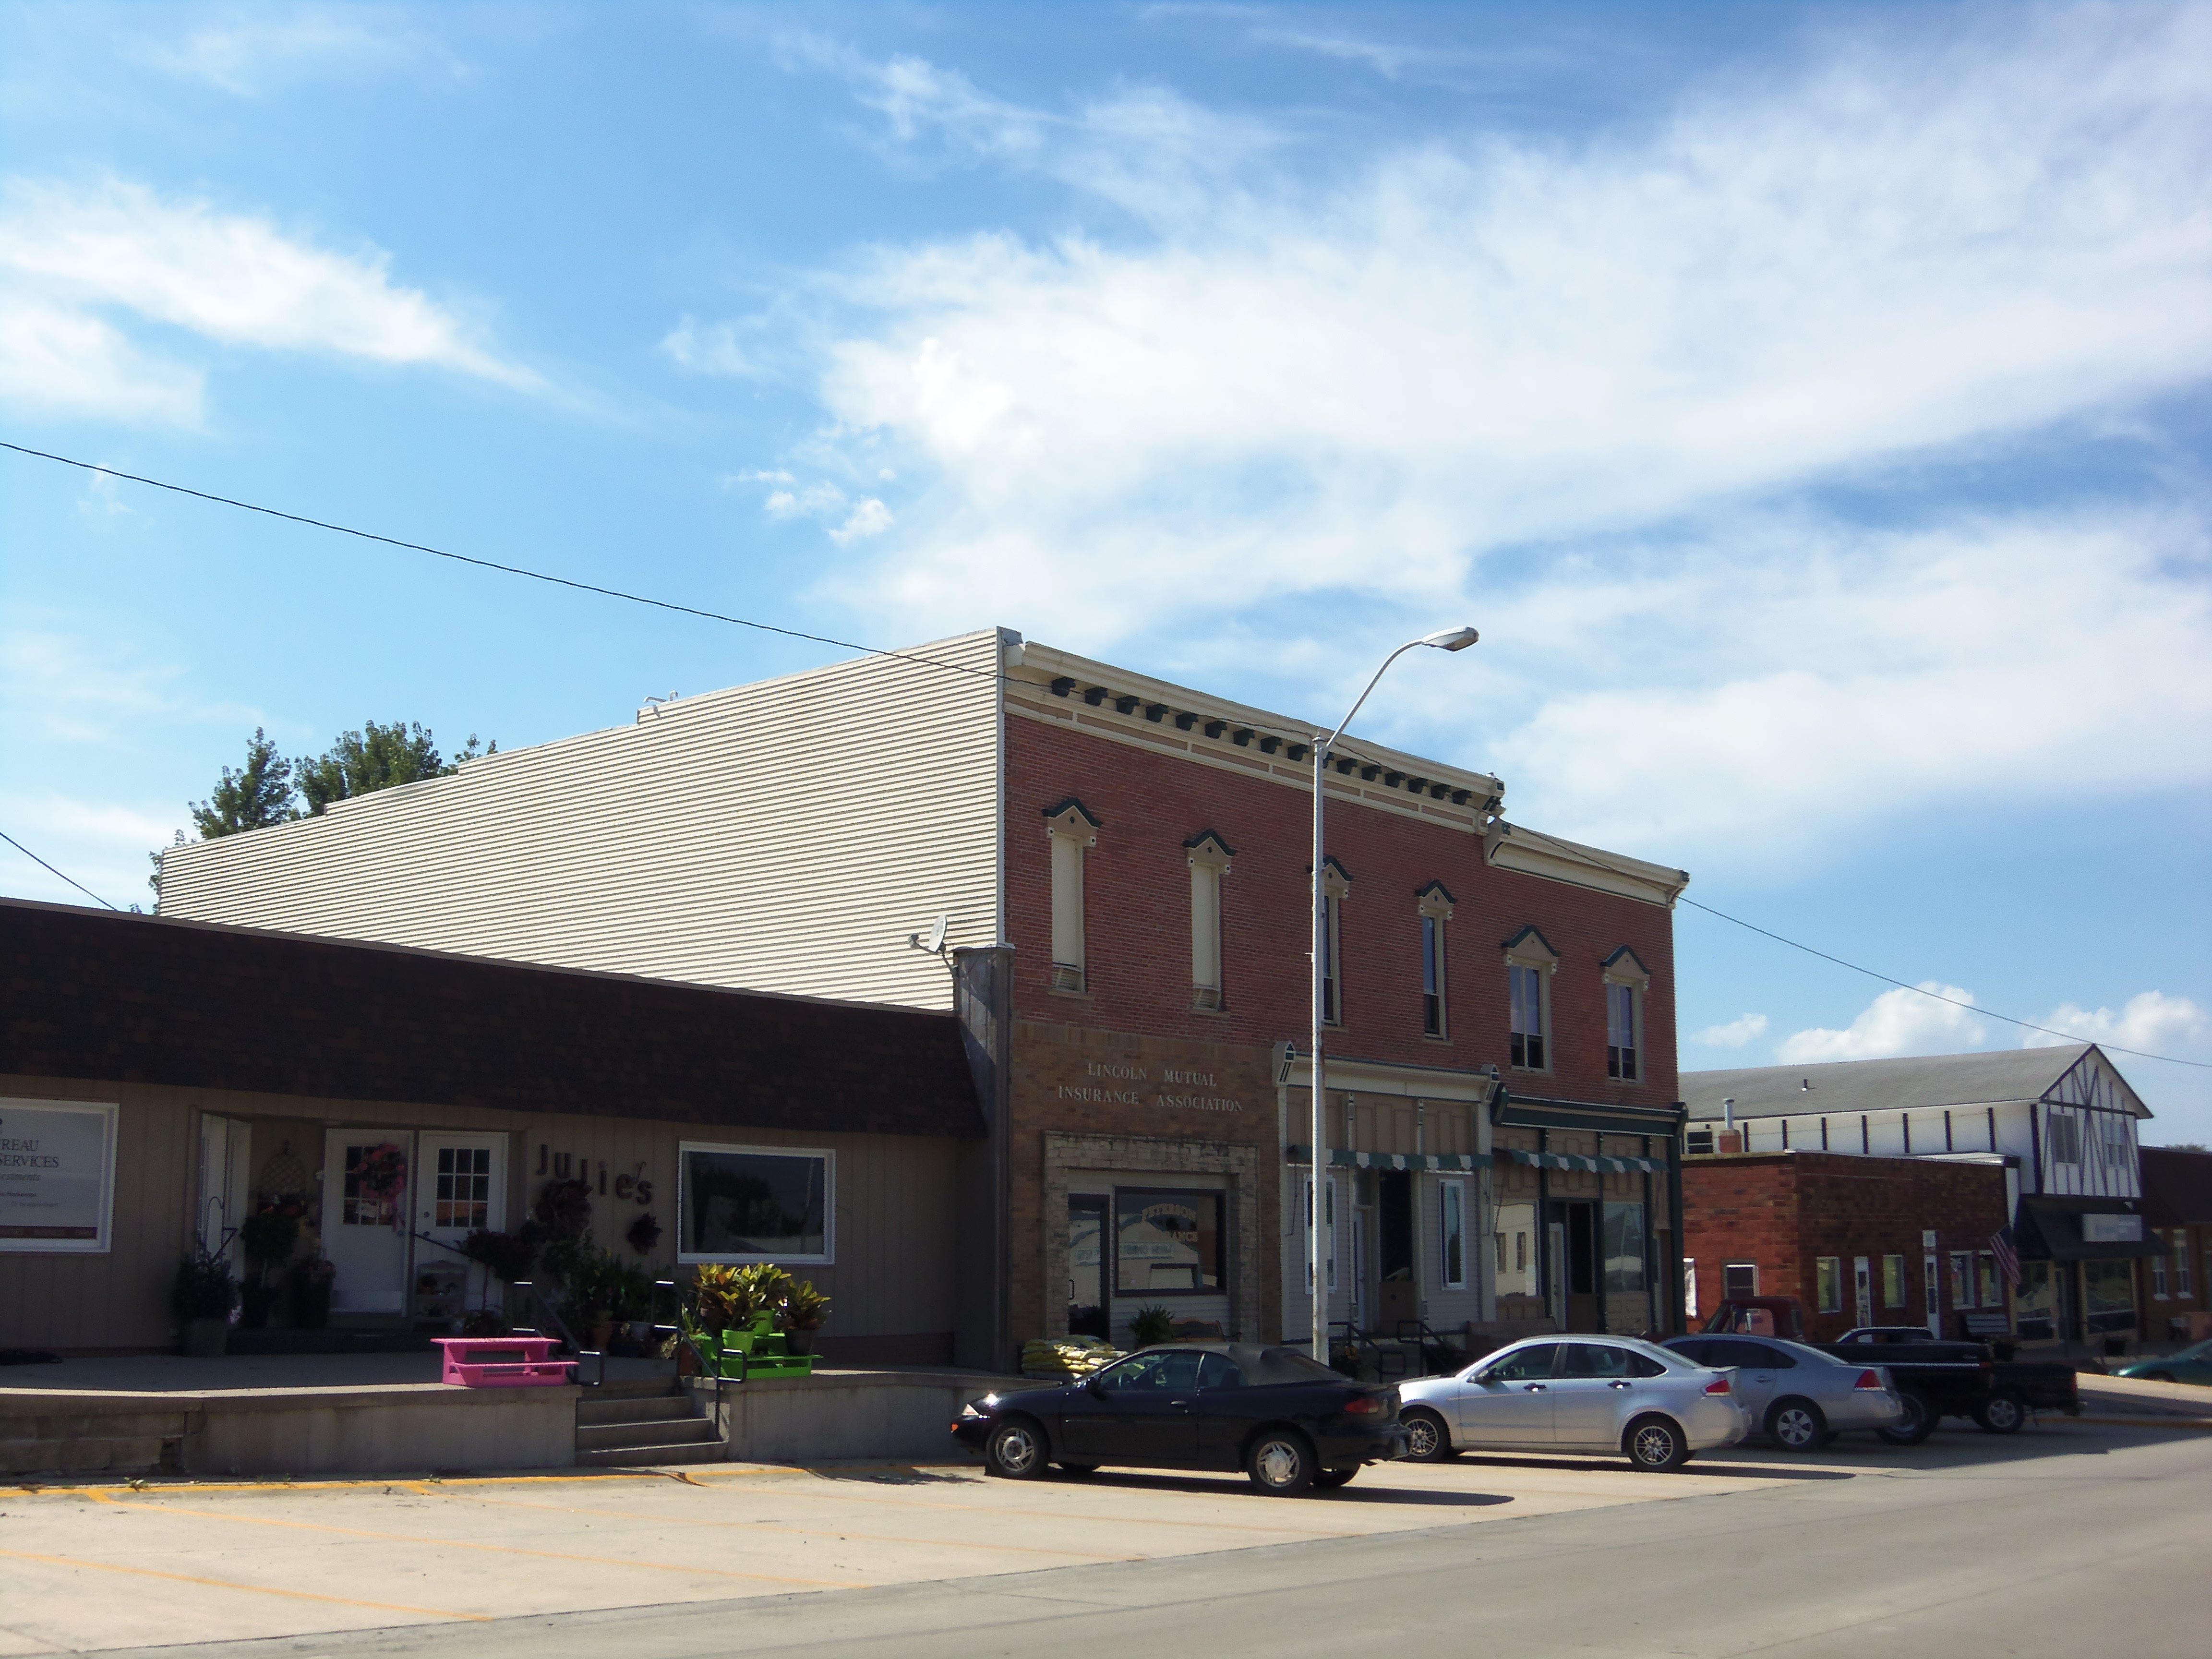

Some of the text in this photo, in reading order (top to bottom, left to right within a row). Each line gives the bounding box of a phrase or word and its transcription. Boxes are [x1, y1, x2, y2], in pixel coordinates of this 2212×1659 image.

[1088, 1063, 1217, 1087] LINCOLN MUTUAL
[1058, 1085, 1243, 1112] INSURANCE ASSOCIATION
[0, 1138, 39, 1152] REAU
